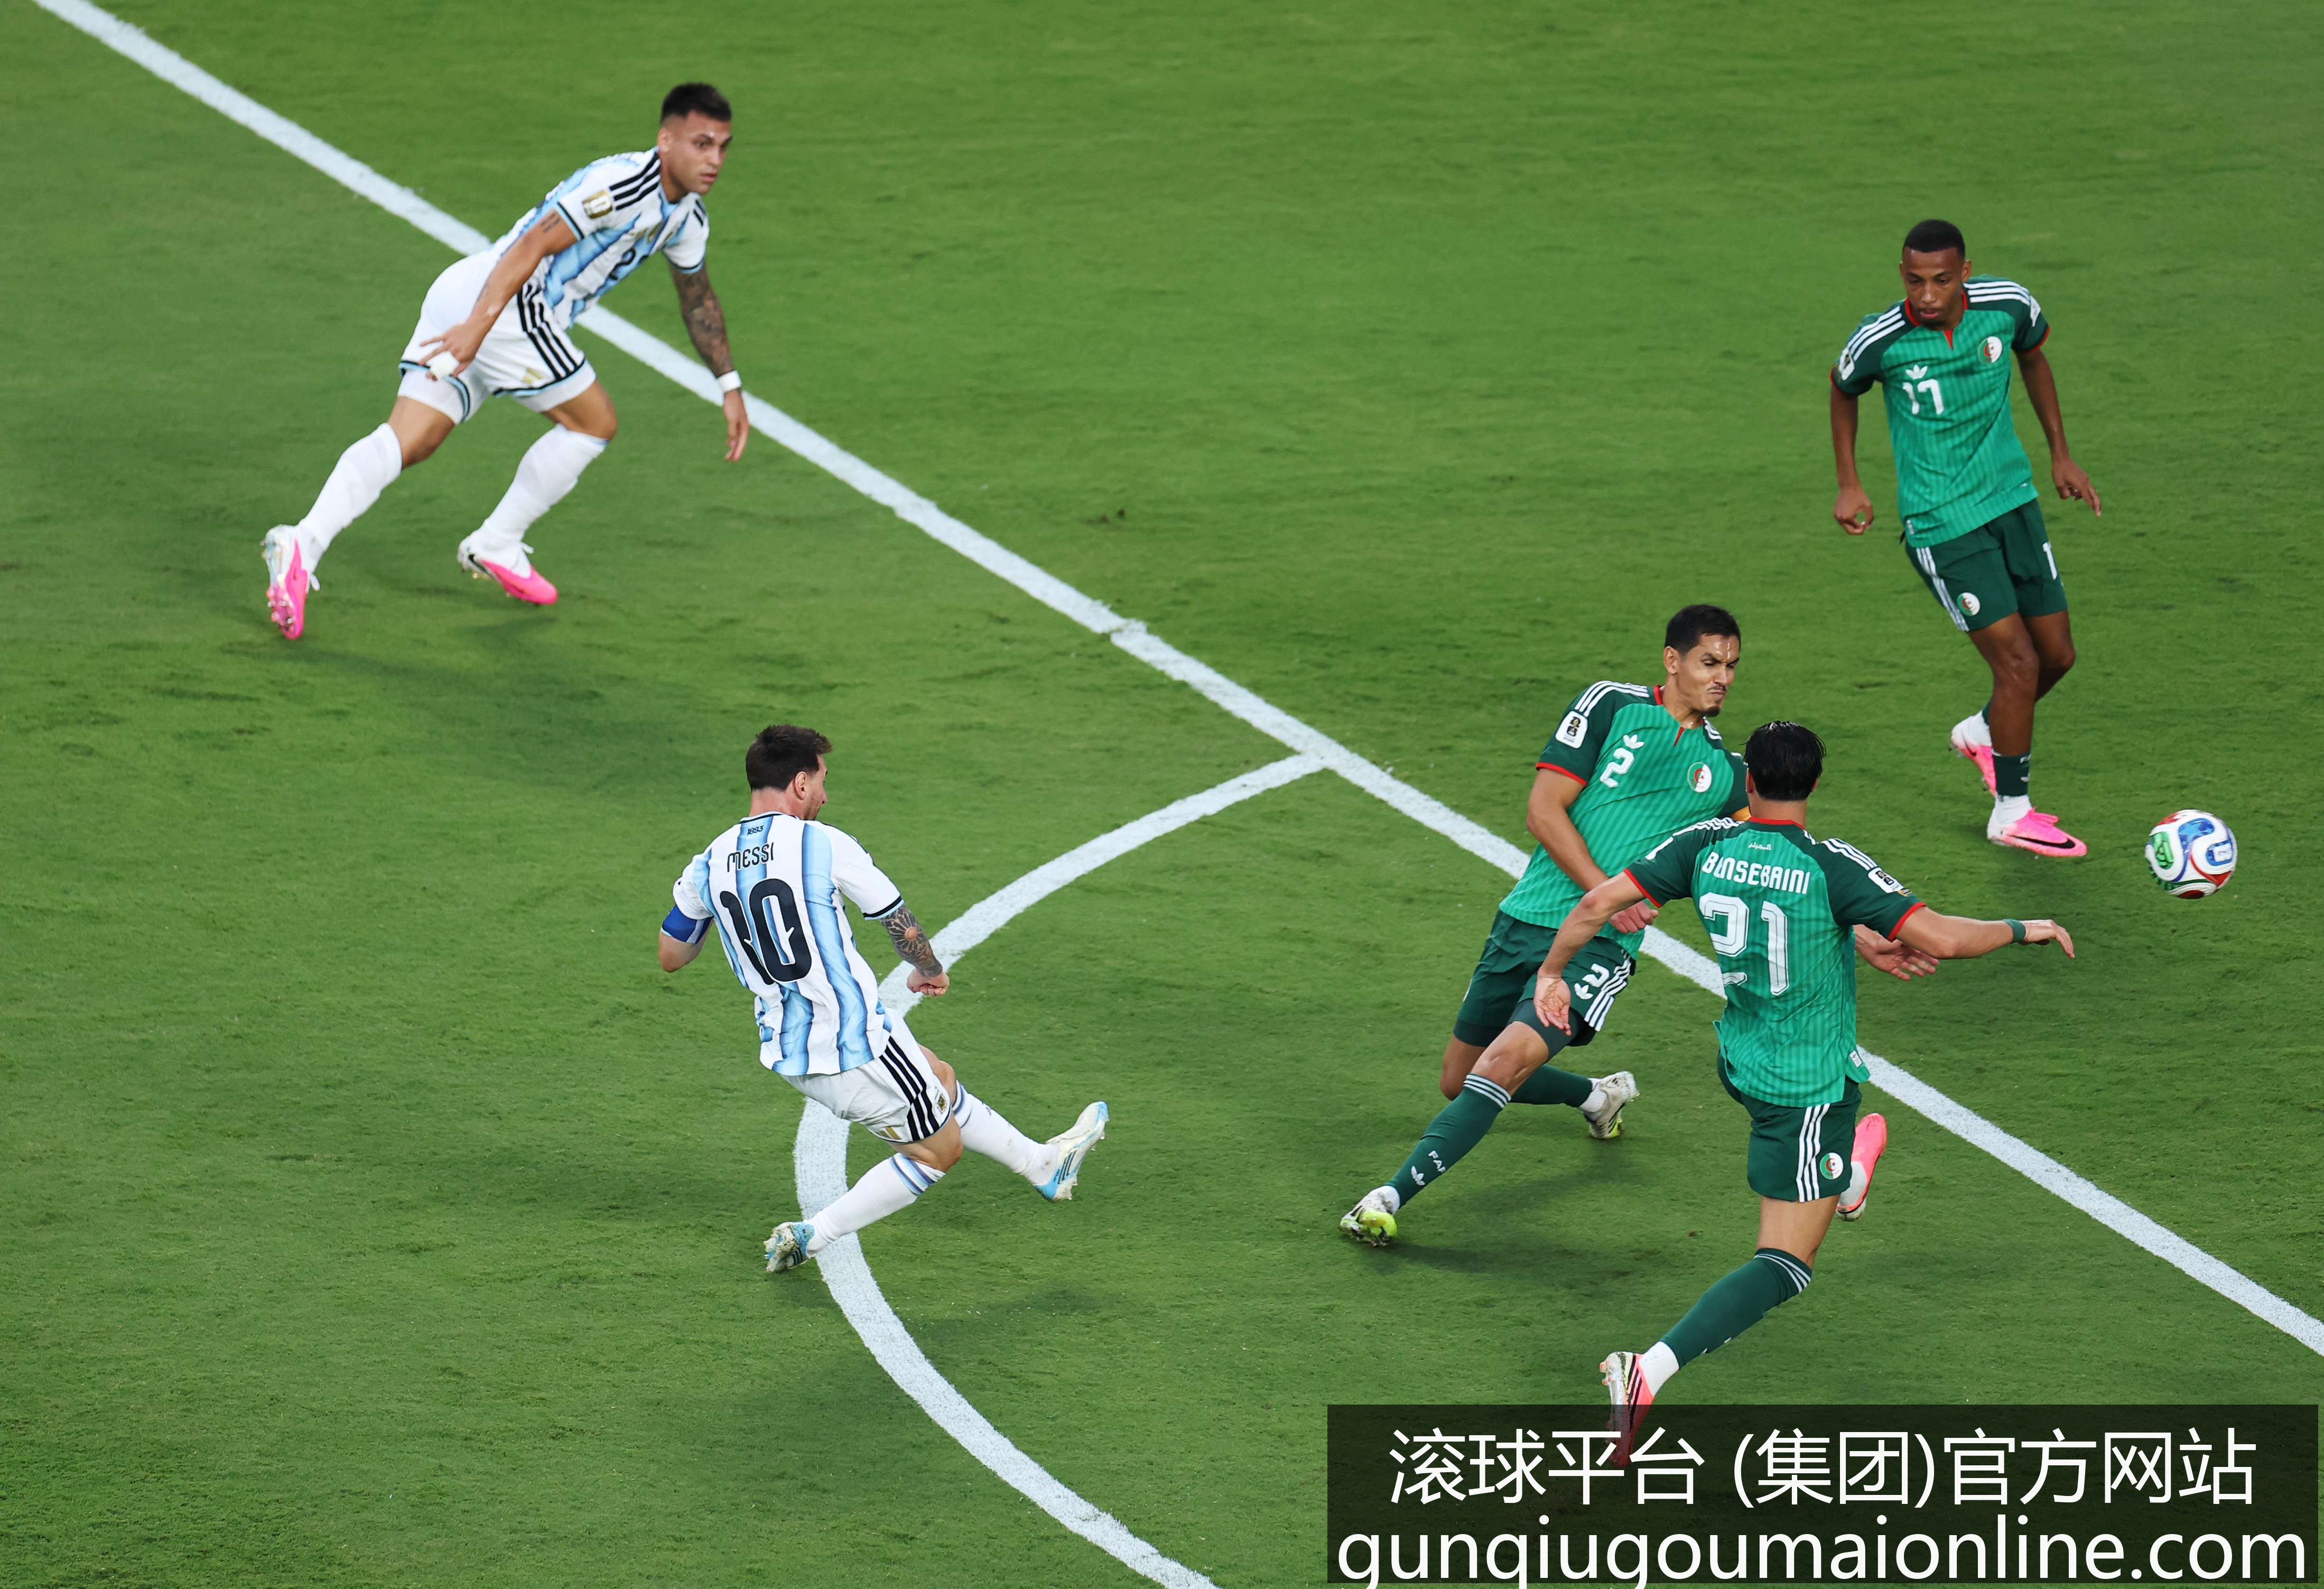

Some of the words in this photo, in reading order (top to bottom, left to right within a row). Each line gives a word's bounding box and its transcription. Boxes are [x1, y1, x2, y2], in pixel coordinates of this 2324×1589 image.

[1902, 378, 1945, 415] 17
[2042, 541, 2058, 580] 1
[1600, 747, 1635, 788] 2
[747, 825, 765, 835] 1893
[727, 842, 774, 872] MESSI
[720, 878, 812, 985] 10
[1699, 891, 1790, 996] 21
[1428, 1150, 1446, 1173] FAF
